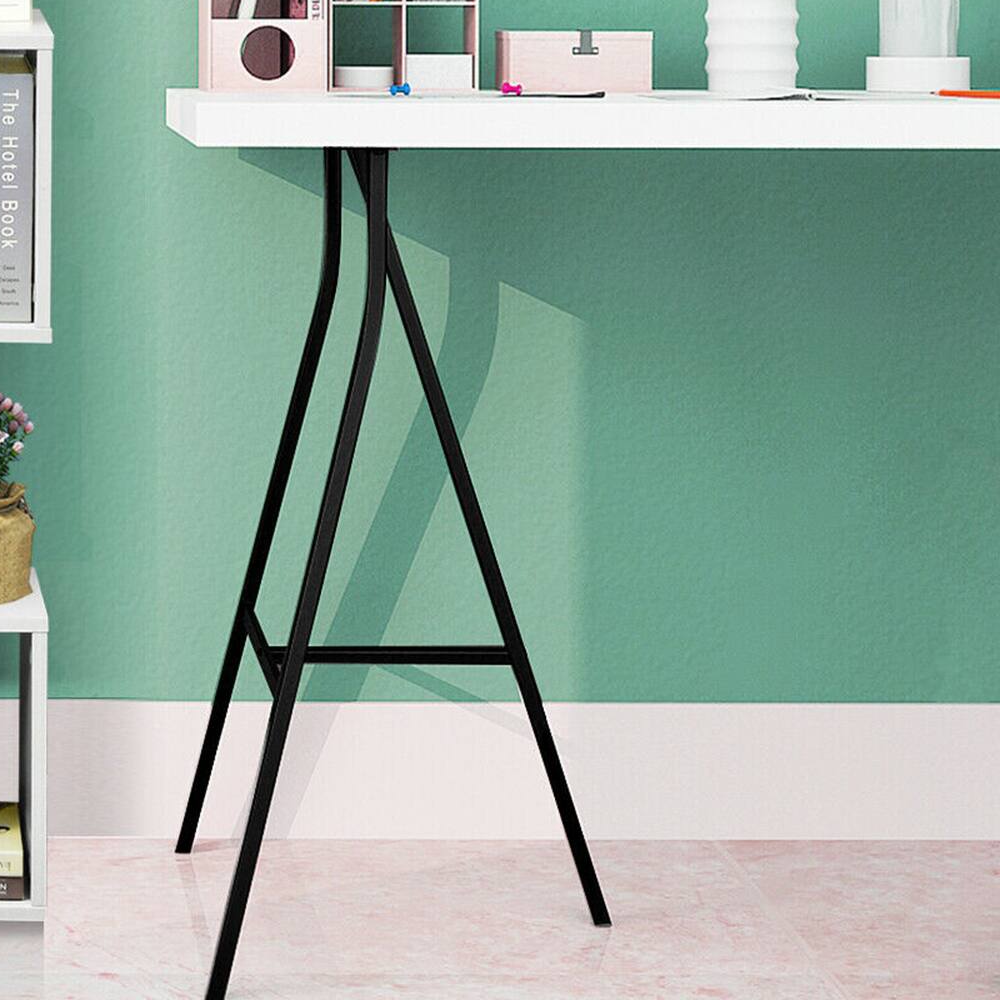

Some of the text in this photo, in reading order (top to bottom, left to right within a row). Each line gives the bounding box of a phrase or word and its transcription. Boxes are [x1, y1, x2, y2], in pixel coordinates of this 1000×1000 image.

[1, 89, 19, 248] The Hotel Book
